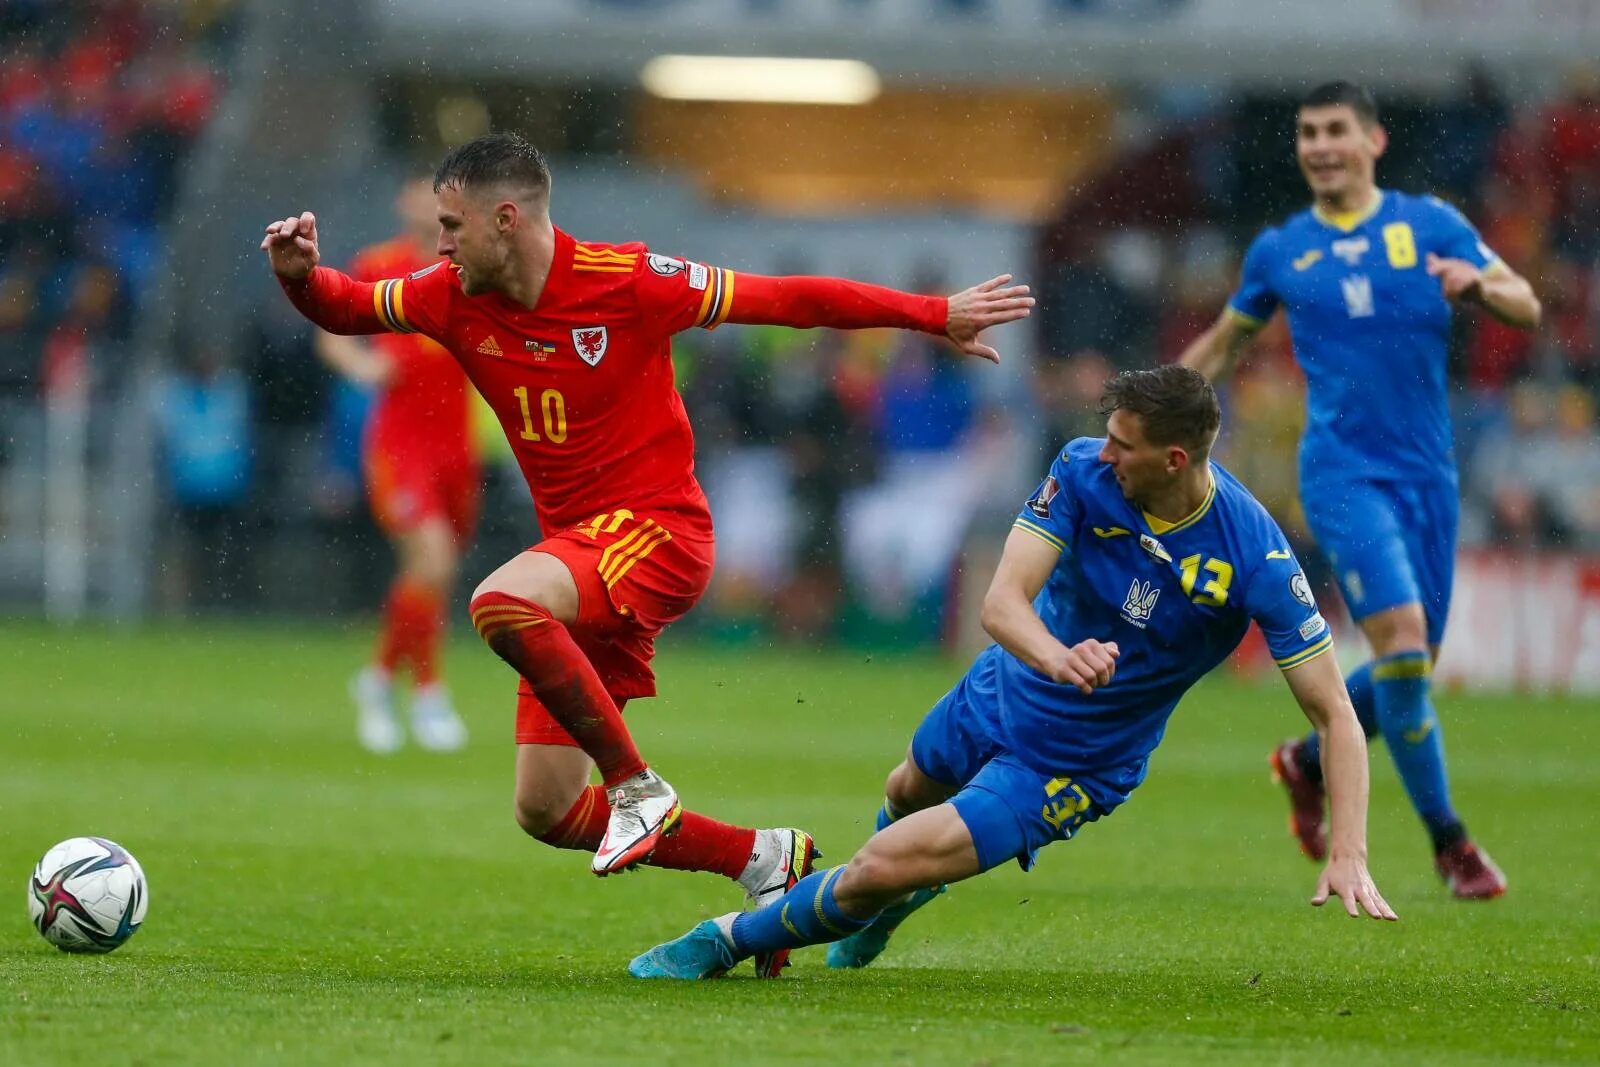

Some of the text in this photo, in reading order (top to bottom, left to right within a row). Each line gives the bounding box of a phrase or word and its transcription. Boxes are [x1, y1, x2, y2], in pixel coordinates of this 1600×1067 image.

[1383, 221, 1418, 269] 8
[476, 347, 503, 357] adidas
[513, 386, 567, 443] 10
[1180, 553, 1233, 607] 13
[1119, 612, 1147, 629] UKRAINE
